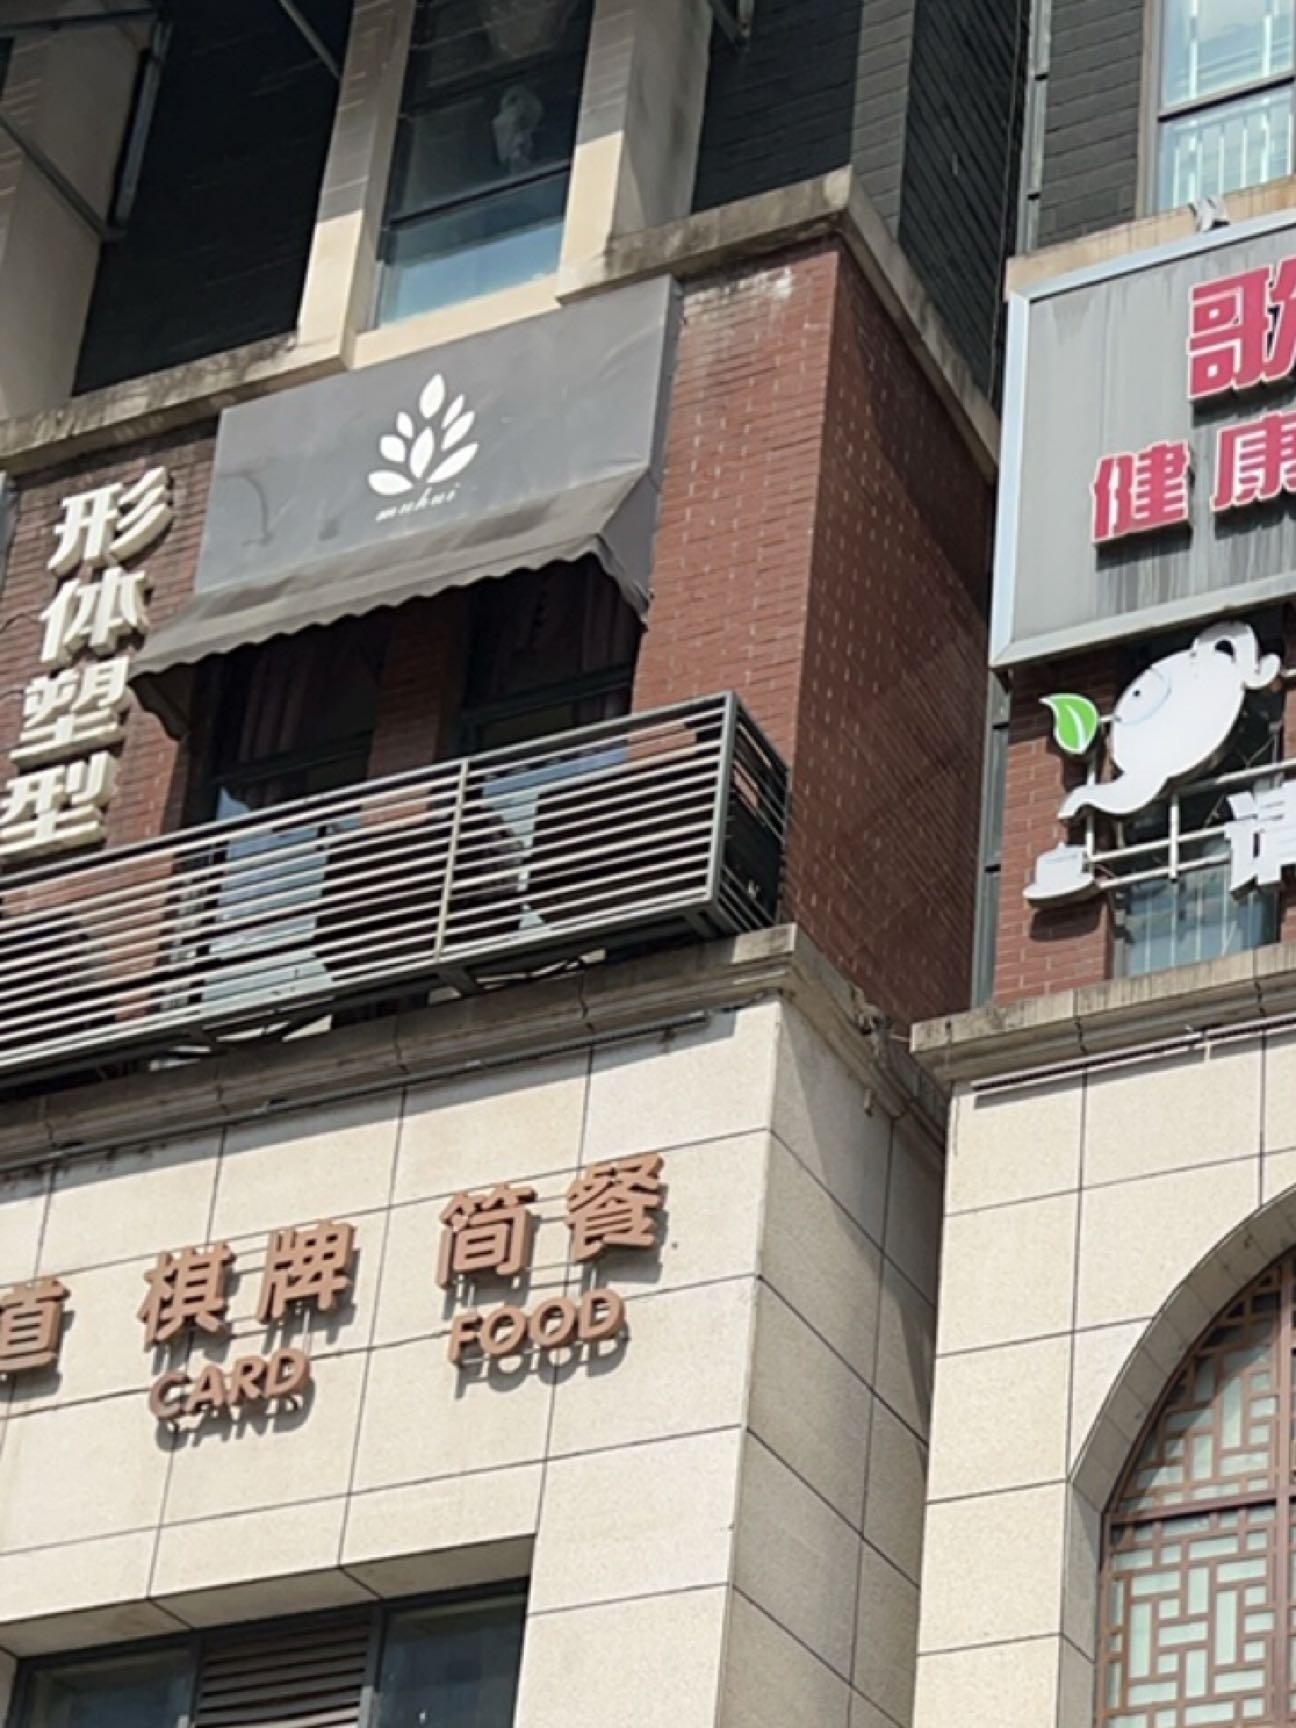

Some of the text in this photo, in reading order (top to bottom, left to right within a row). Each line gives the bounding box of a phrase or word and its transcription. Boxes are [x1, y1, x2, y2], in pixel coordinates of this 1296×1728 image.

[0, 465, 174, 861] 形体塑型
[137, 1218, 358, 1351] 棋牌
[436, 1152, 665, 1290] 简餐
[149, 1347, 312, 1421] CARD
[447, 1289, 626, 1366] FOOD
